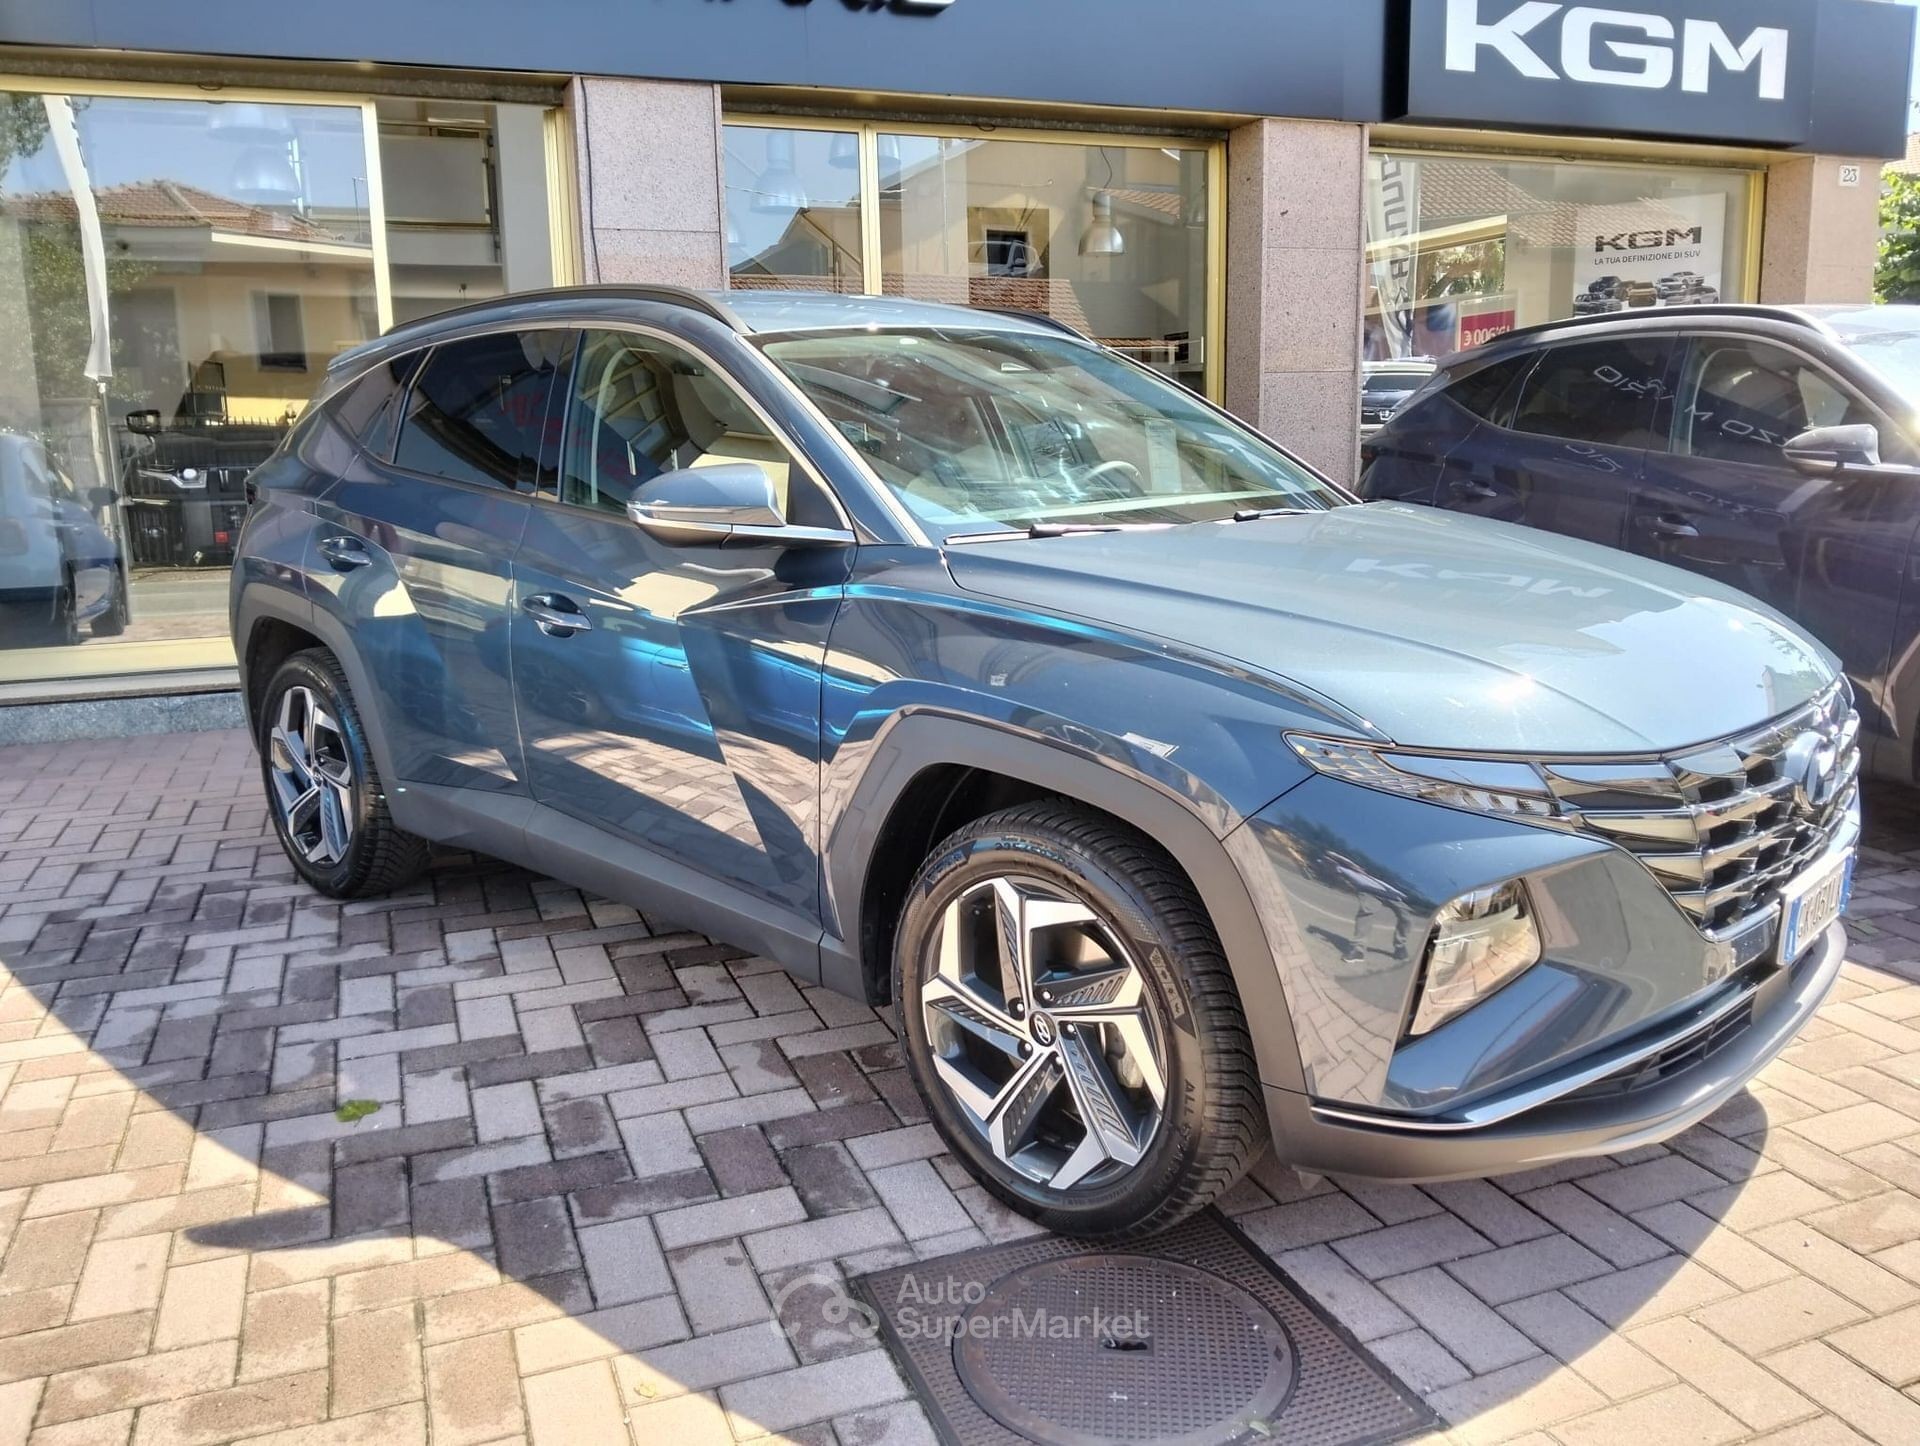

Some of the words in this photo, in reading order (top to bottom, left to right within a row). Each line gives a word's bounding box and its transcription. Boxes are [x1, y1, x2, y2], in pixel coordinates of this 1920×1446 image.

[1445, 0, 1788, 100] KGM
[1843, 168, 1857, 182] 23
[1595, 226, 1702, 252] KGM
[1594, 257, 1604, 265] LA
[1605, 256, 1621, 264] TUA
[1622, 252, 1672, 263] DEFINIZIONE
[1674, 251, 1683, 259] DI
[1684, 250, 1701, 258] SUV
